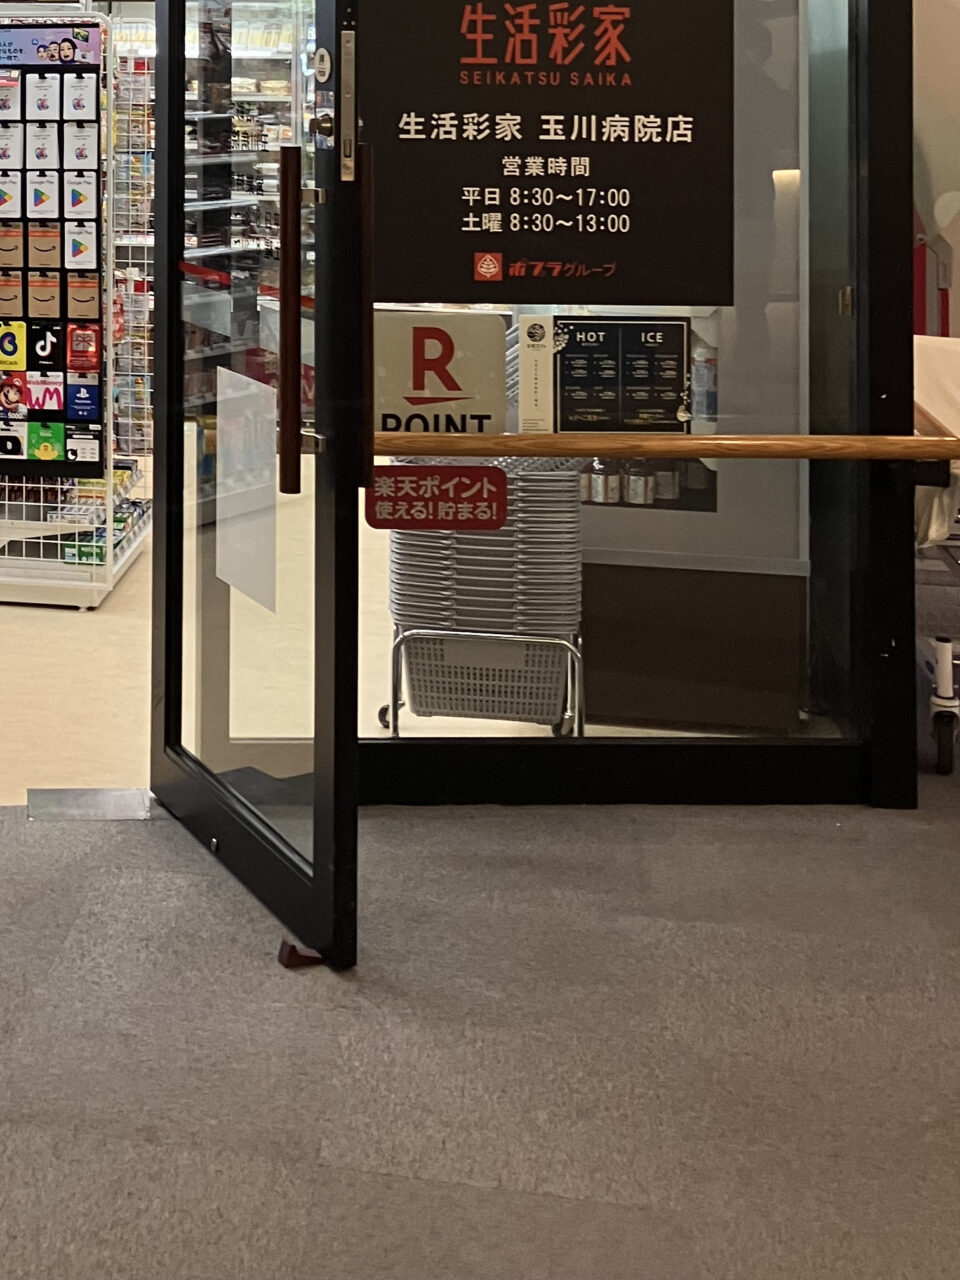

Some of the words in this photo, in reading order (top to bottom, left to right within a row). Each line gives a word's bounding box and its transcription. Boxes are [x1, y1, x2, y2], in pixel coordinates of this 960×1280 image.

[459, 2, 632, 66] 生活彩家
[459, 71, 560, 85] SEIKATSU
[570, 72, 631, 86] SAIKA
[398, 111, 523, 141] 生活彩家
[538, 114, 694, 143] 玉川病院店
[501, 156, 590, 177] 営業時間
[461, 187, 500, 206] 平日
[461, 212, 503, 233] 土曜
[509, 258, 617, 278] ポプラグループ
[576, 332, 605, 342] HOT
[641, 332, 663, 343] ICE
[412, 326, 463, 392] R
[381, 413, 492, 433] POINT
[374, 475, 498, 498] 楽天ポイント
